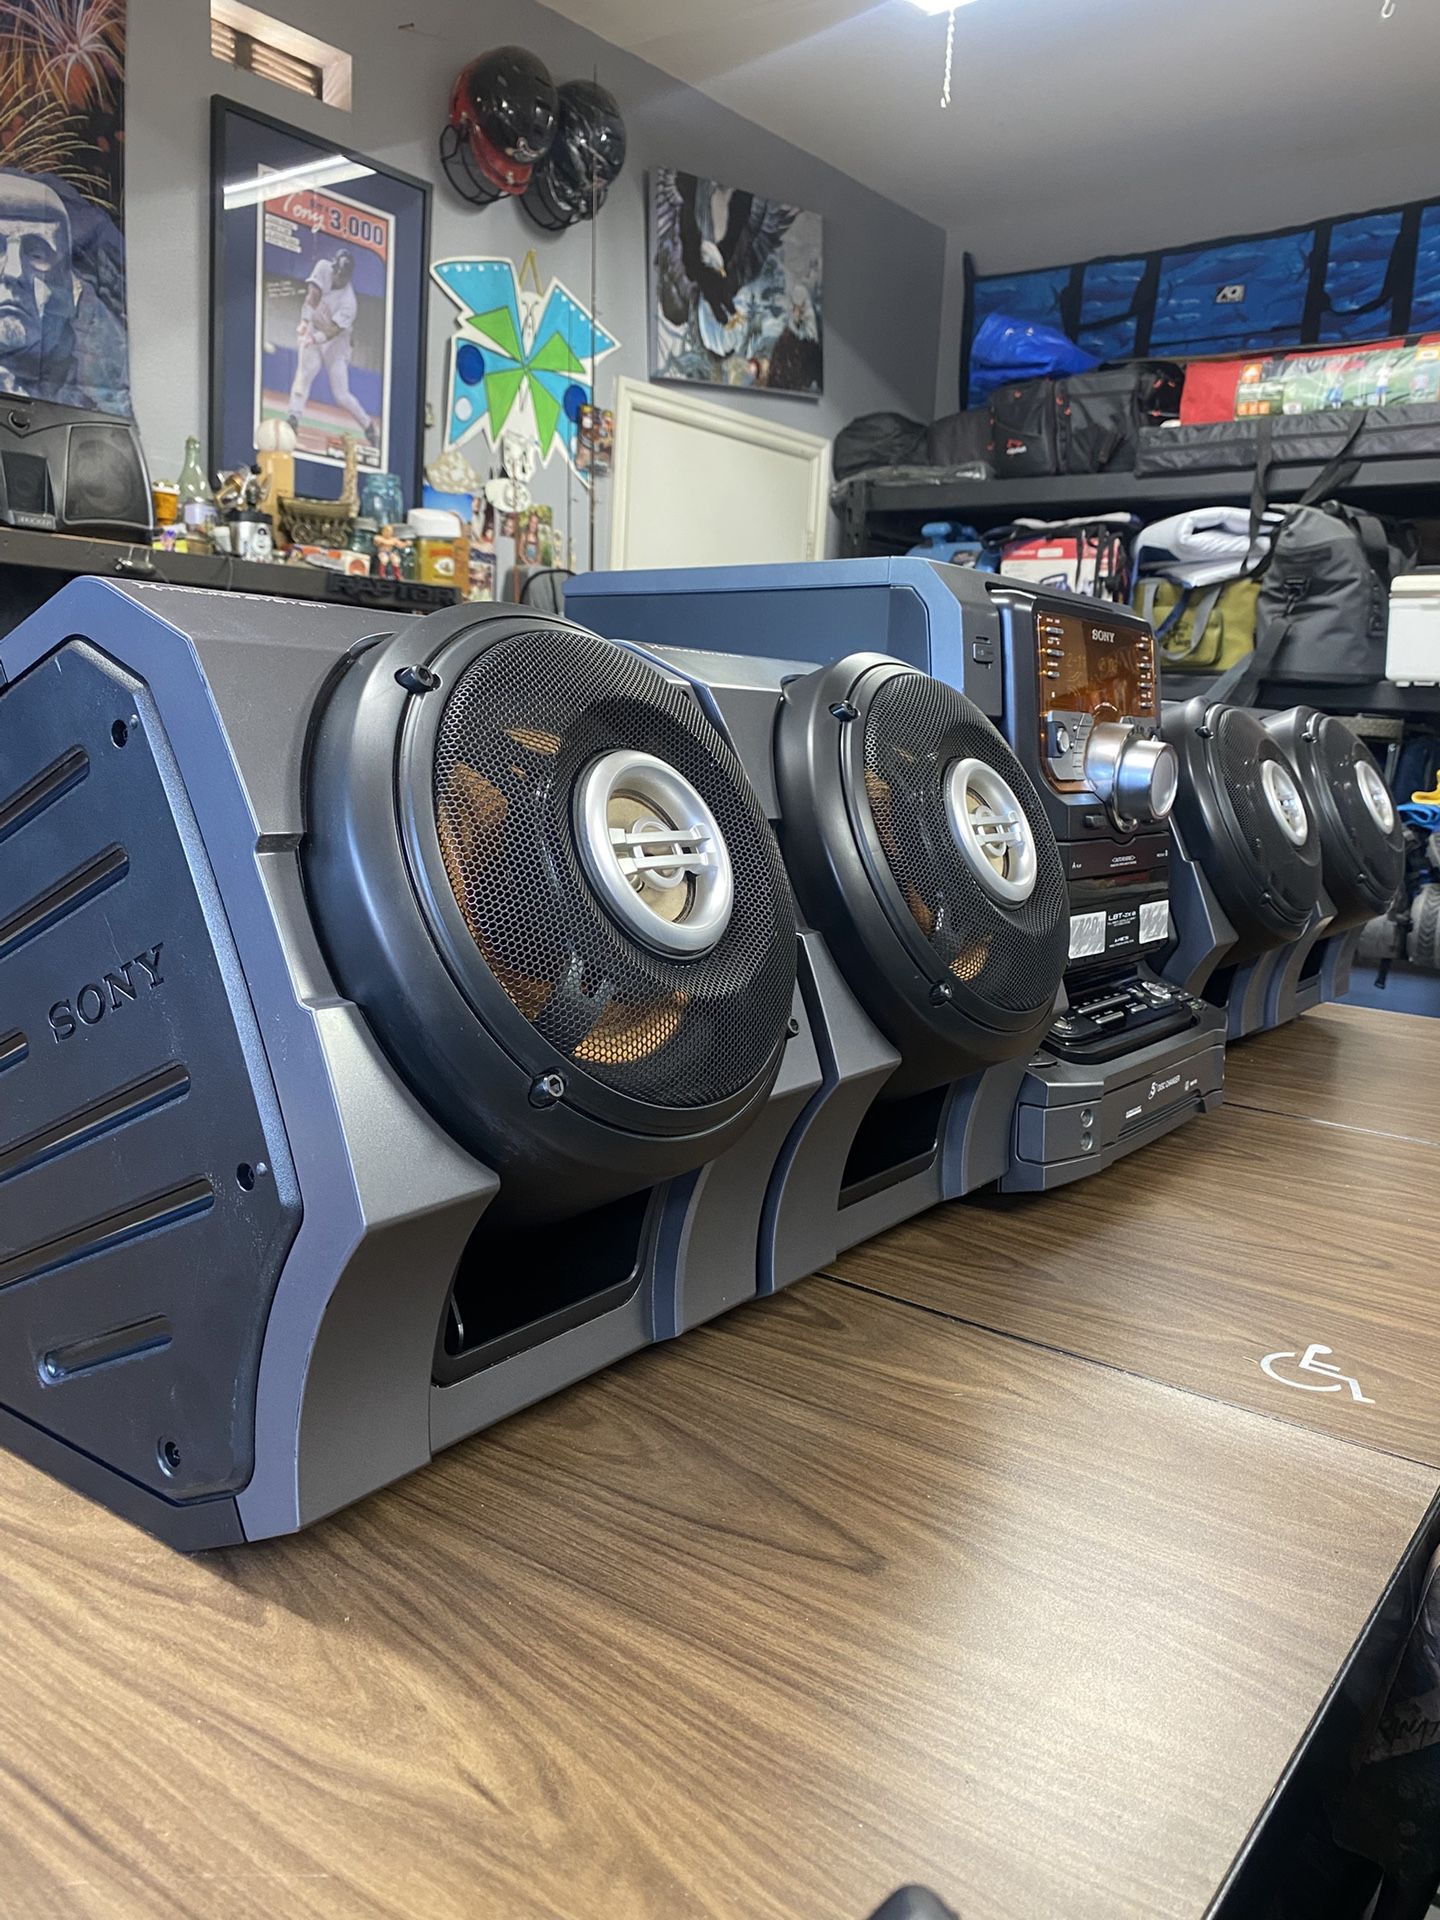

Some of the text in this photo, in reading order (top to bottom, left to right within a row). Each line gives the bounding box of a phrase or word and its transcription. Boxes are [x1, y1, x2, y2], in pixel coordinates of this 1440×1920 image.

[326, 570, 459, 607] RAPTOR
[1091, 627, 1116, 643] SONY
[47, 941, 165, 1044] SONY
